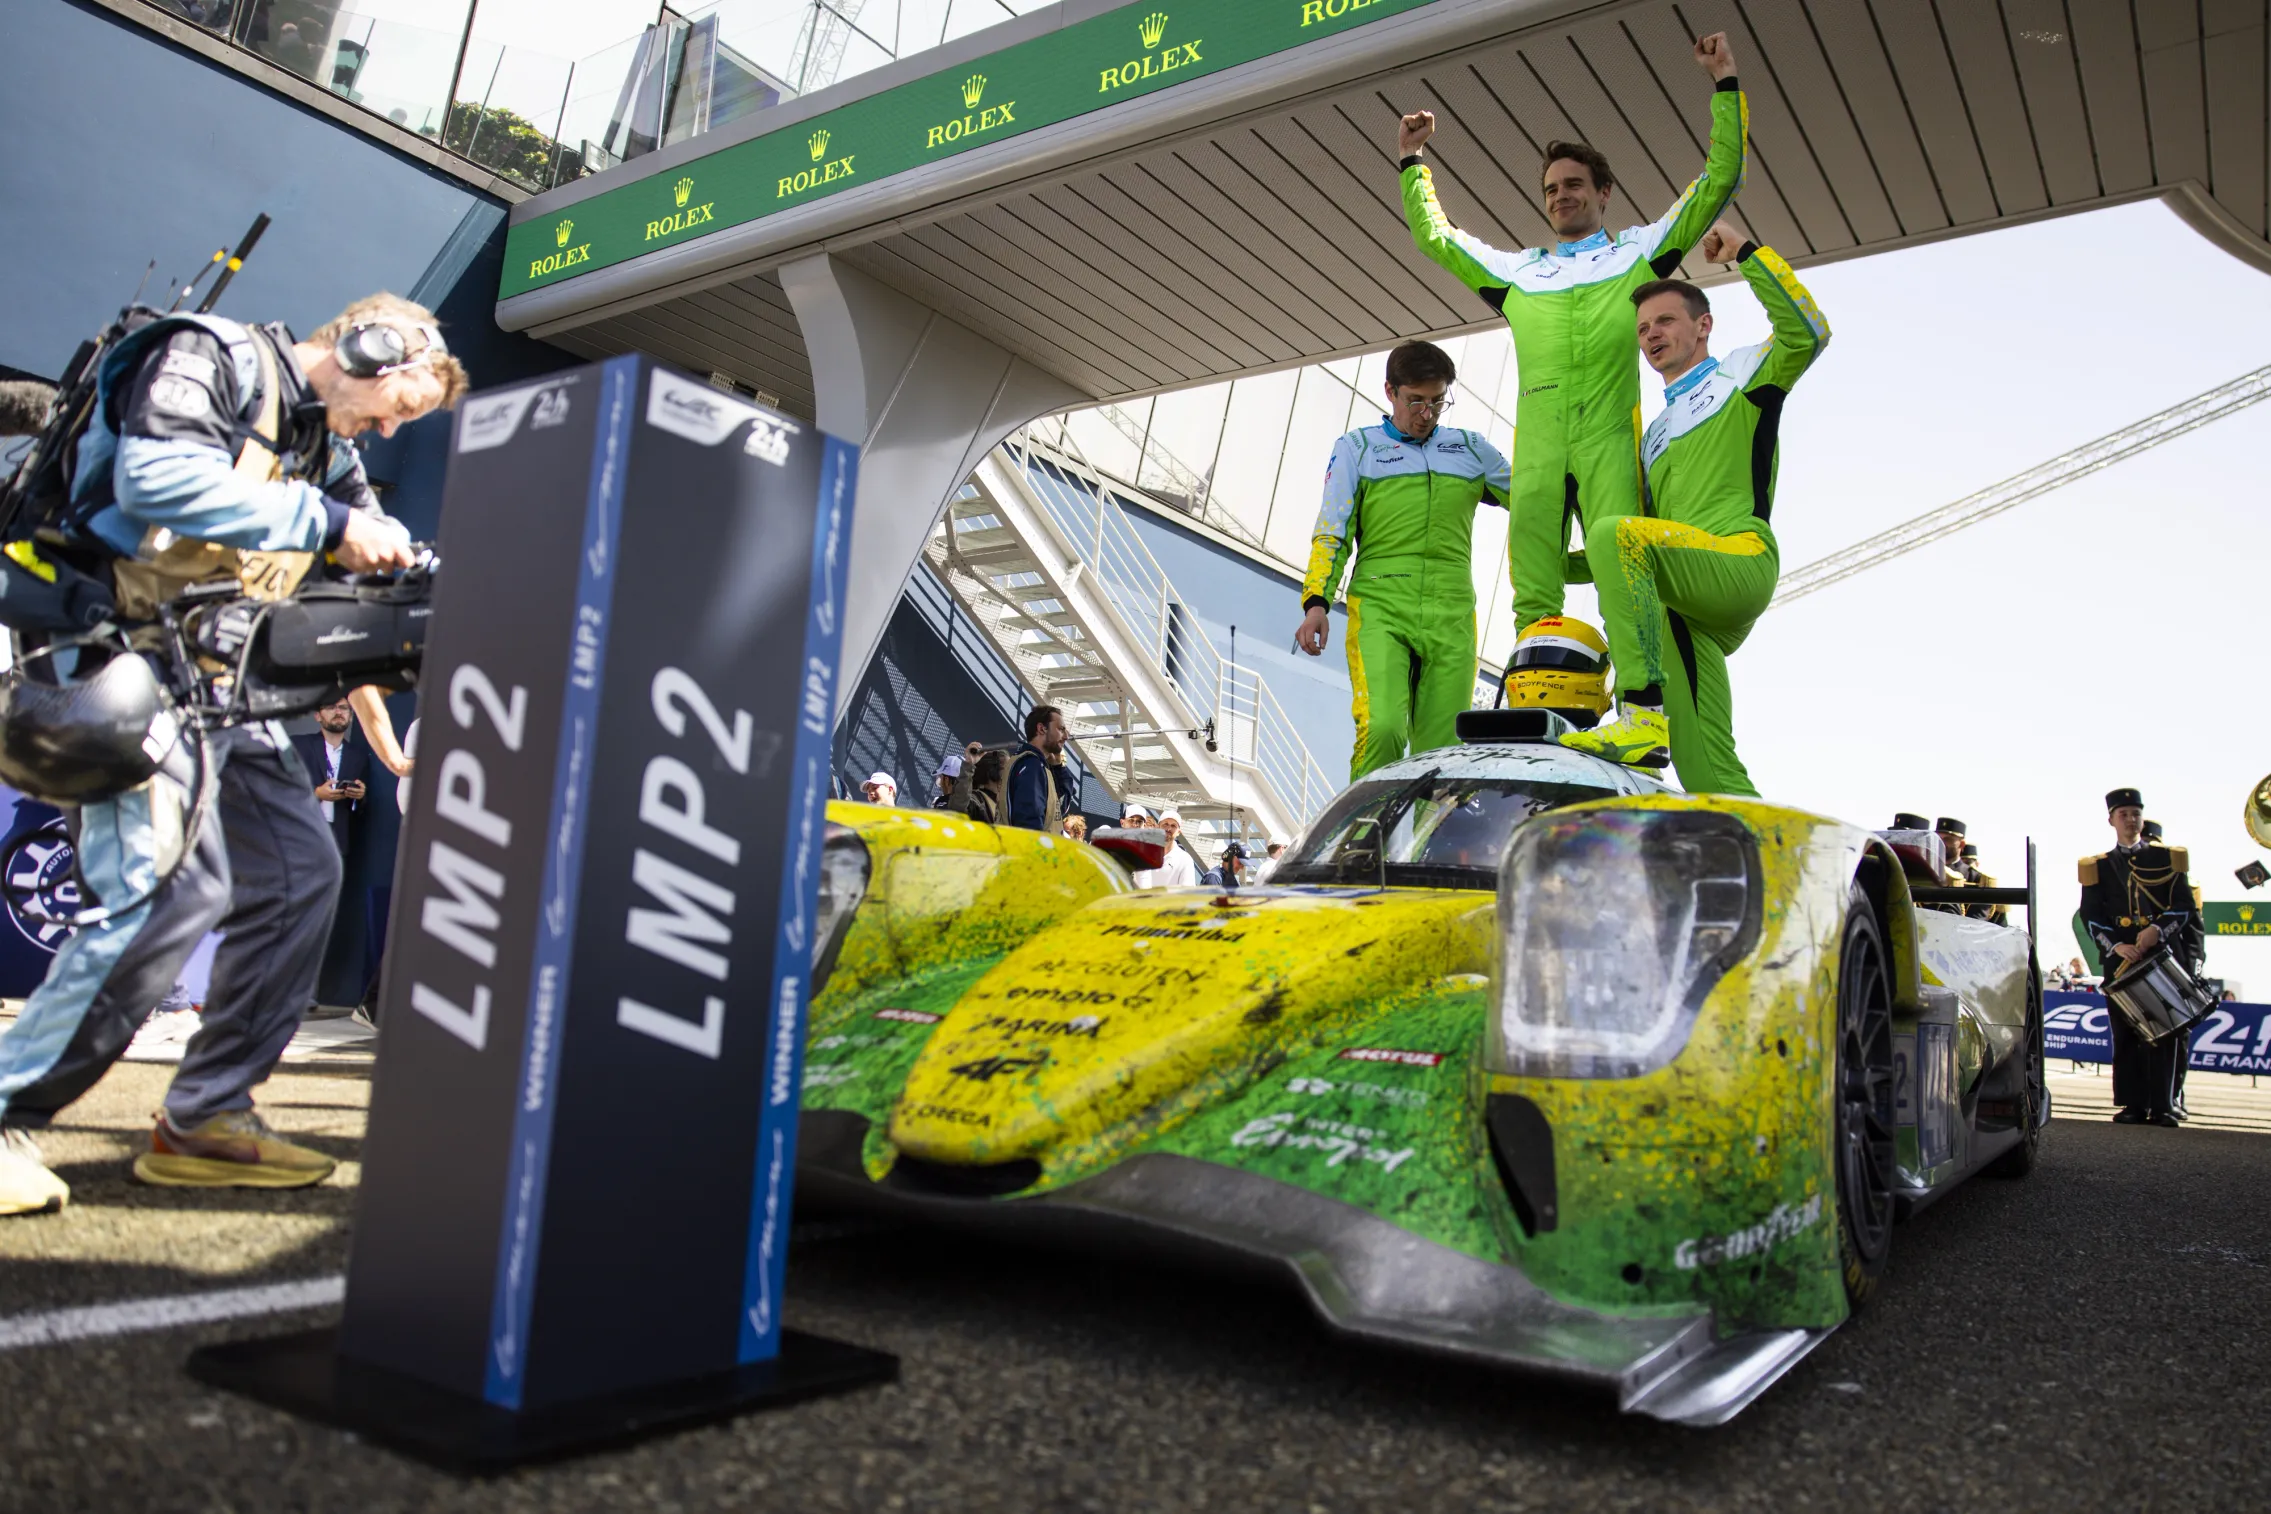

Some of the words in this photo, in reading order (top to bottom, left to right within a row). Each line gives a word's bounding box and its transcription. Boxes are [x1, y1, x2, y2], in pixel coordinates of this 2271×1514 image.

[1098, 39, 1203, 93] ROLEX
[926, 101, 1016, 149] ROLEX
[776, 155, 855, 198] ROLEX
[645, 202, 715, 241] ROLEX
[528, 243, 591, 279] ROLEX
[571, 604, 605, 691] LMP2
[802, 656, 832, 735] LMP2
[411, 663, 528, 1051] LMP2
[616, 666, 754, 1060] LMP2
[524, 965, 559, 1112] WINNER
[770, 975, 800, 1106] WINNER
[2046, 1033, 2109, 1047] ENDURANCE
[2189, 1052, 2215, 1067] LE
[2219, 1053, 2271, 1070] MAN
